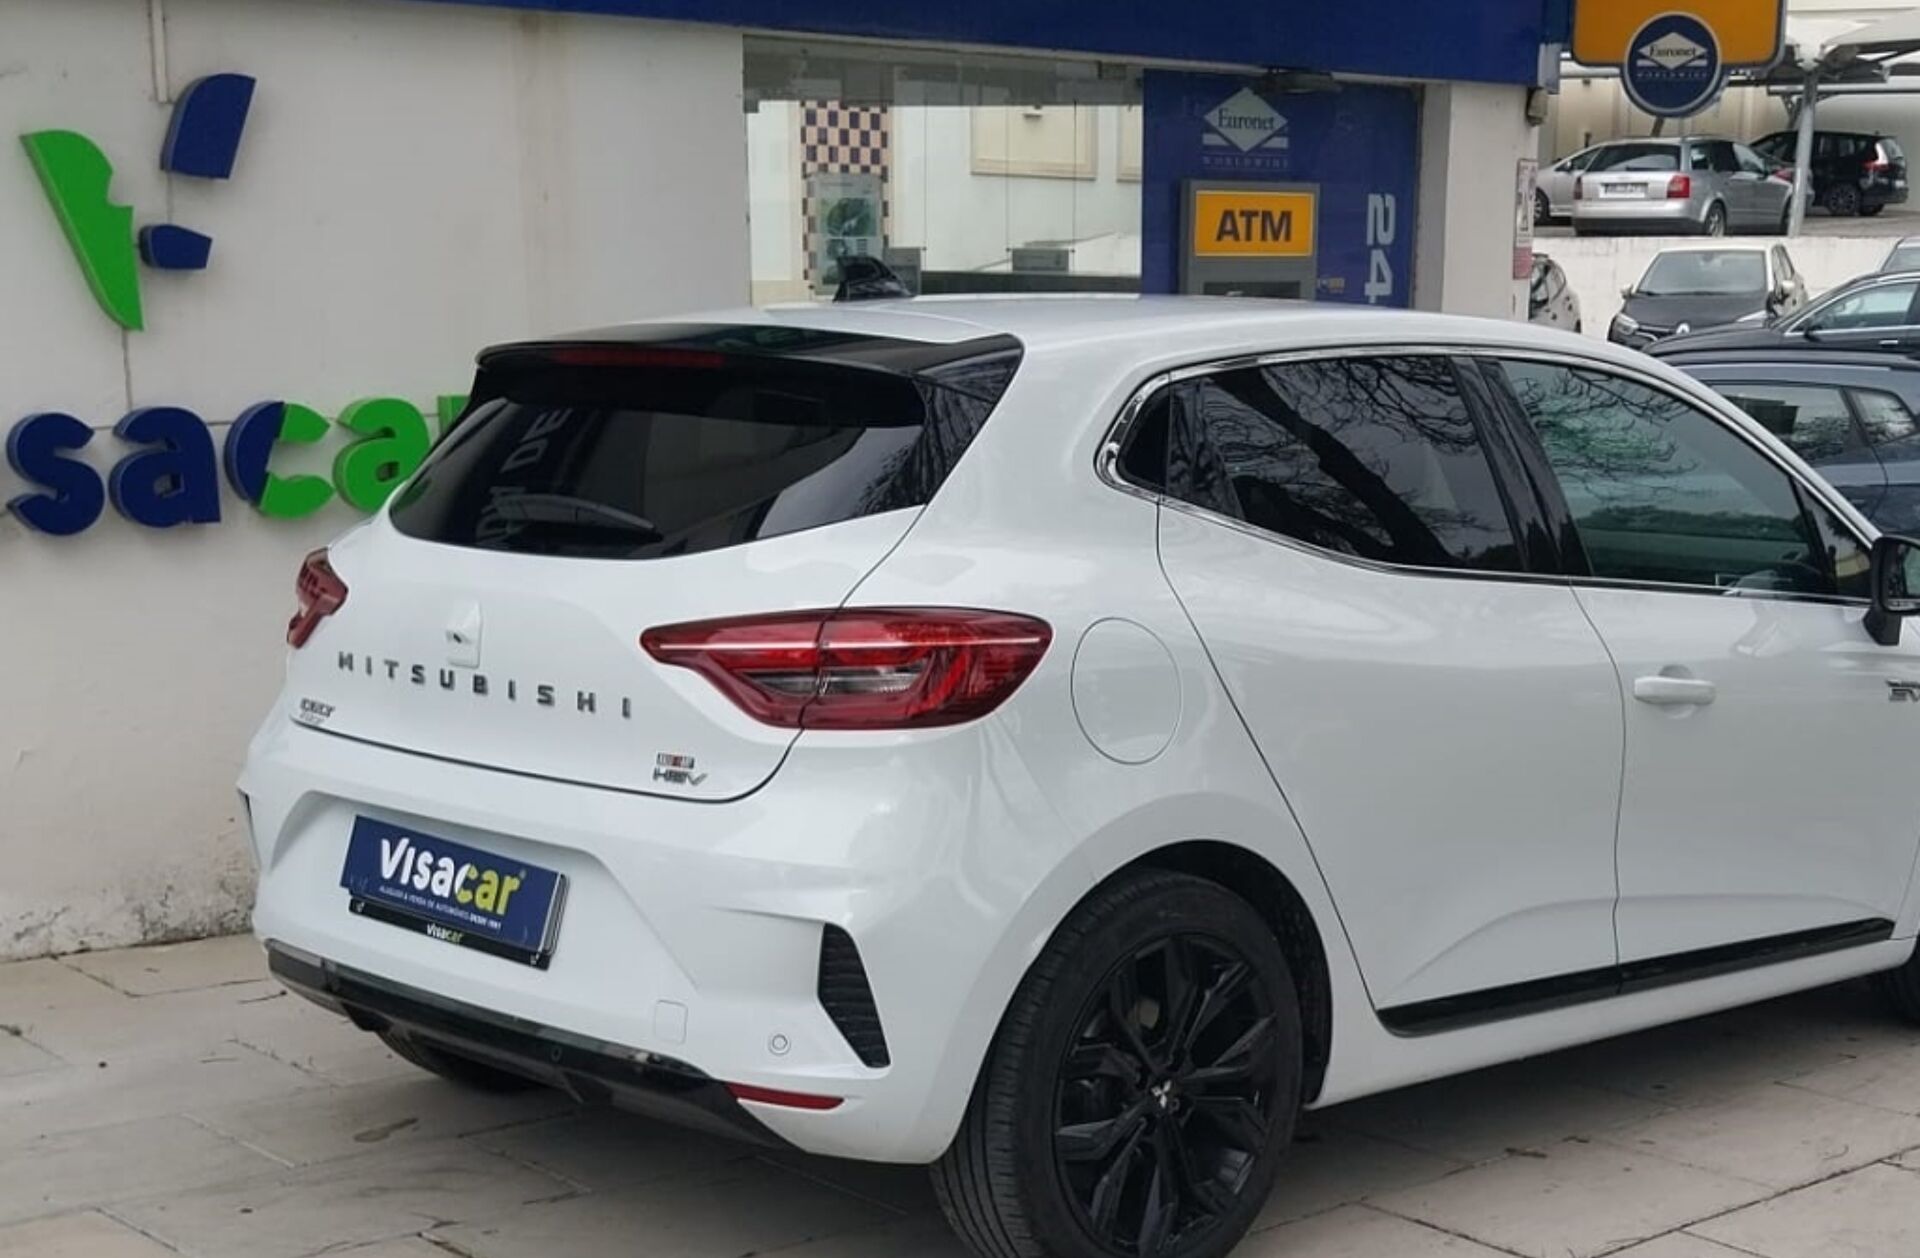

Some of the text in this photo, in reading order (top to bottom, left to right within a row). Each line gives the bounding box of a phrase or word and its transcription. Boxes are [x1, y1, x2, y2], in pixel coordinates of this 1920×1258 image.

[1648, 44, 1697, 58] Euronet
[1217, 107, 1275, 130] Euronet
[1216, 209, 1293, 242] ATM
[6, 395, 470, 536] saca
[338, 651, 632, 719] MITSUBISHI
[381, 837, 520, 915] Visacar
